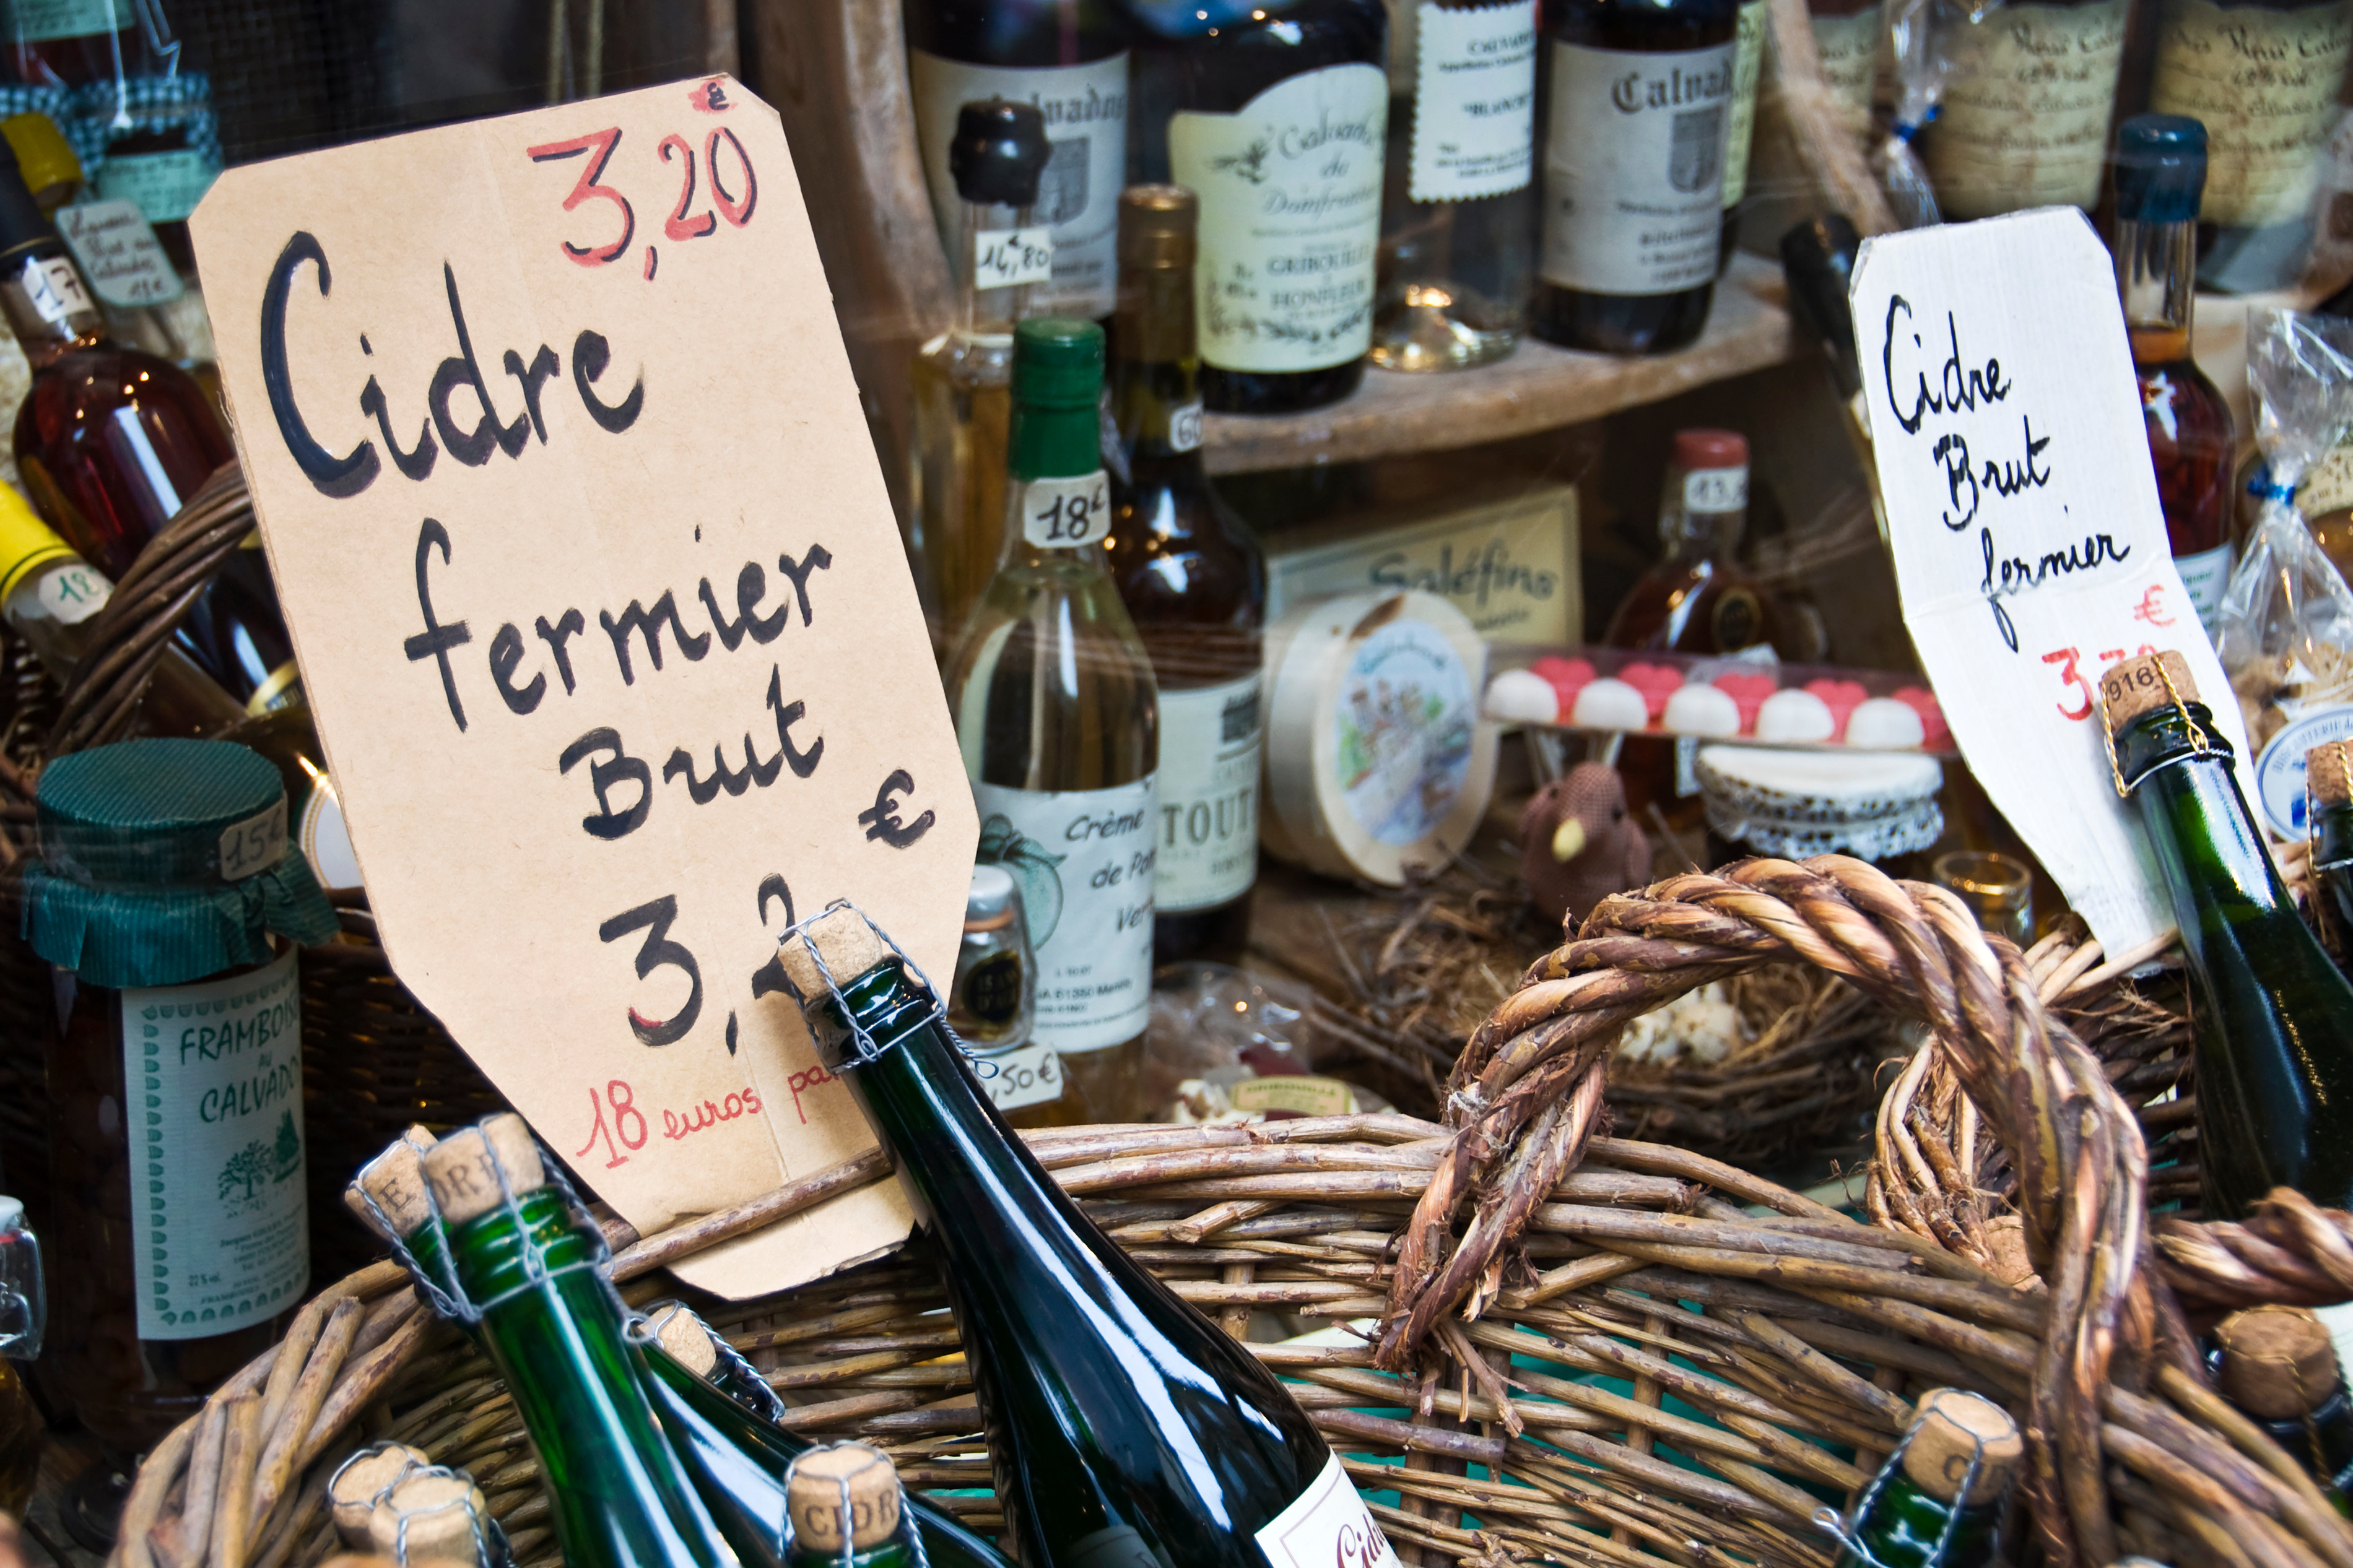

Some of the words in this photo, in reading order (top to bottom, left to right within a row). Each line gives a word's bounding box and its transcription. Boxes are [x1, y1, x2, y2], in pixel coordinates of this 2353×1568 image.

[1611, 60, 1732, 116] Calvad
[526, 126, 757, 282] 3,20
[261, 230, 645, 499] Cidre
[1883, 293, 2012, 436] Cidre
[1933, 414, 2051, 532] Brut
[404, 517, 832, 734] fermier
[1981, 505, 2131, 654] fermier
[2134, 584, 2176, 628] €
[559, 662, 824, 841] Brut
[857, 768, 935, 849] €
[1064, 809, 1144, 841] Crème
[1090, 859, 1123, 889] de
[1160, 787, 1252, 849] TOUT
[599, 872, 800, 1059] 3,2
[576, 1079, 648, 1169] 18
[663, 1086, 763, 1141] euros
